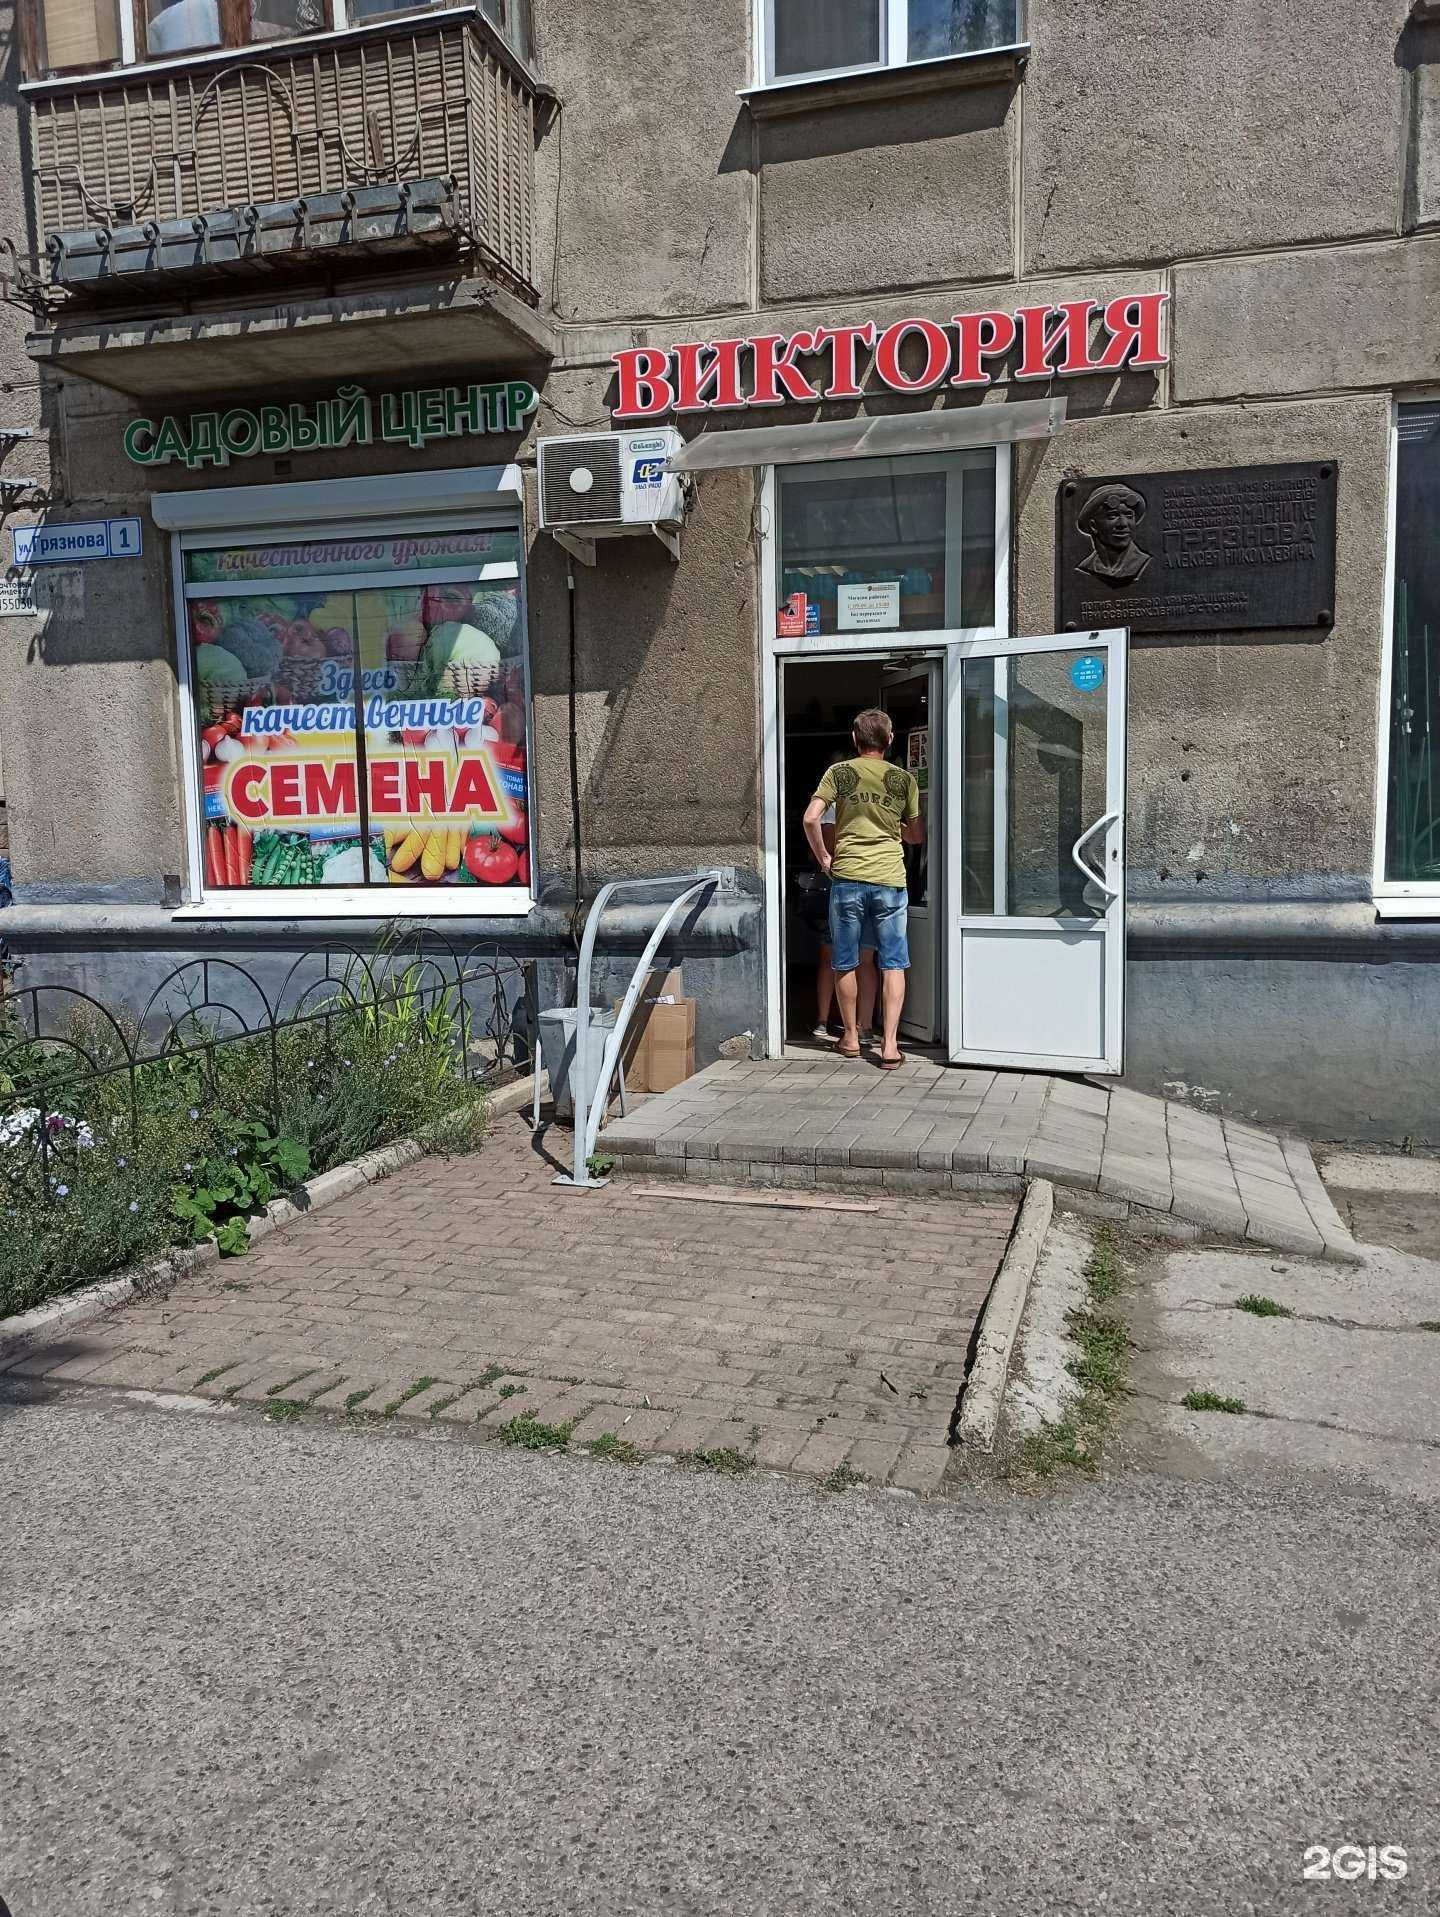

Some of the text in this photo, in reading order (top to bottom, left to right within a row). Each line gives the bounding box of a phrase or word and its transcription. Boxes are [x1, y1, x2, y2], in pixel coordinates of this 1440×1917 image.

[610, 292, 1171, 418] ВИКТОРИЯ
[123, 381, 538, 469] САДОВЫЙ ЦЕНТР
[119, 527, 130, 548] 1
[1161, 521, 1316, 553] ГРЯЗНОВА
[216, 541, 384, 571] качественного
[0, 597, 33, 610] 55030
[320, 662, 397, 696] Здесь
[244, 695, 483, 733] качественные
[230, 759, 498, 818] СЕМЕНА
